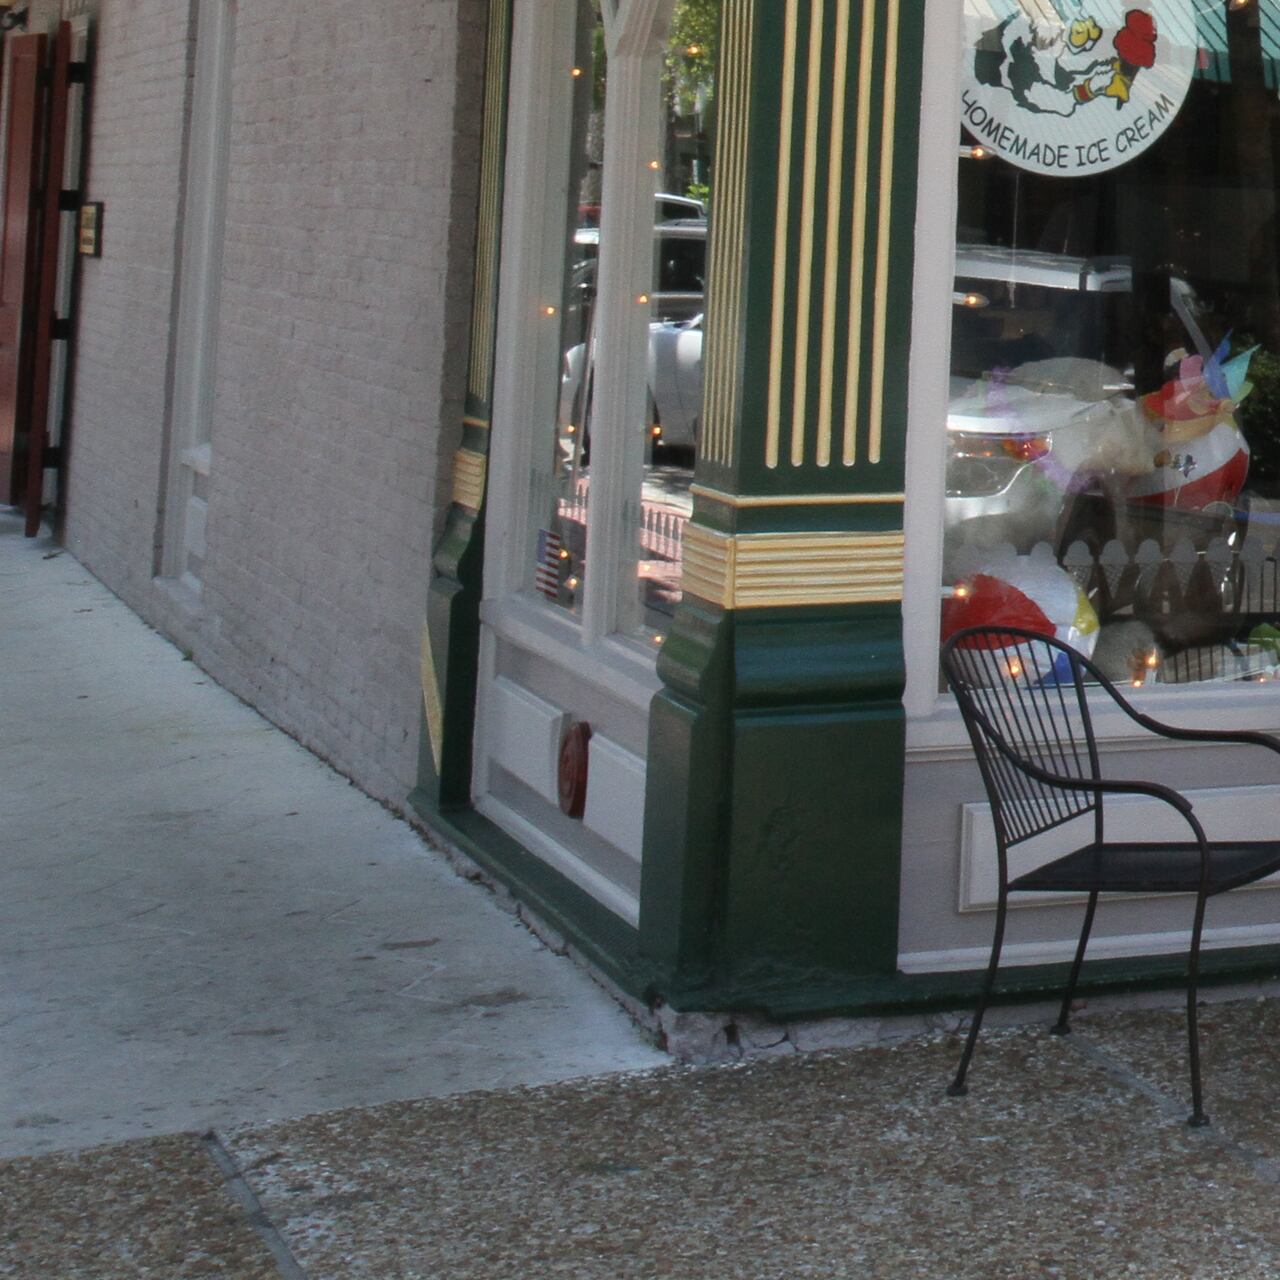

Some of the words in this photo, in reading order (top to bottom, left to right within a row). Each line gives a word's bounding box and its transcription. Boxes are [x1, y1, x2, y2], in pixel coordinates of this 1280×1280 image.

[961, 89, 1068, 169] HOMEMADE
[1076, 138, 1111, 167] ICE
[1115, 93, 1175, 153] CREAM
